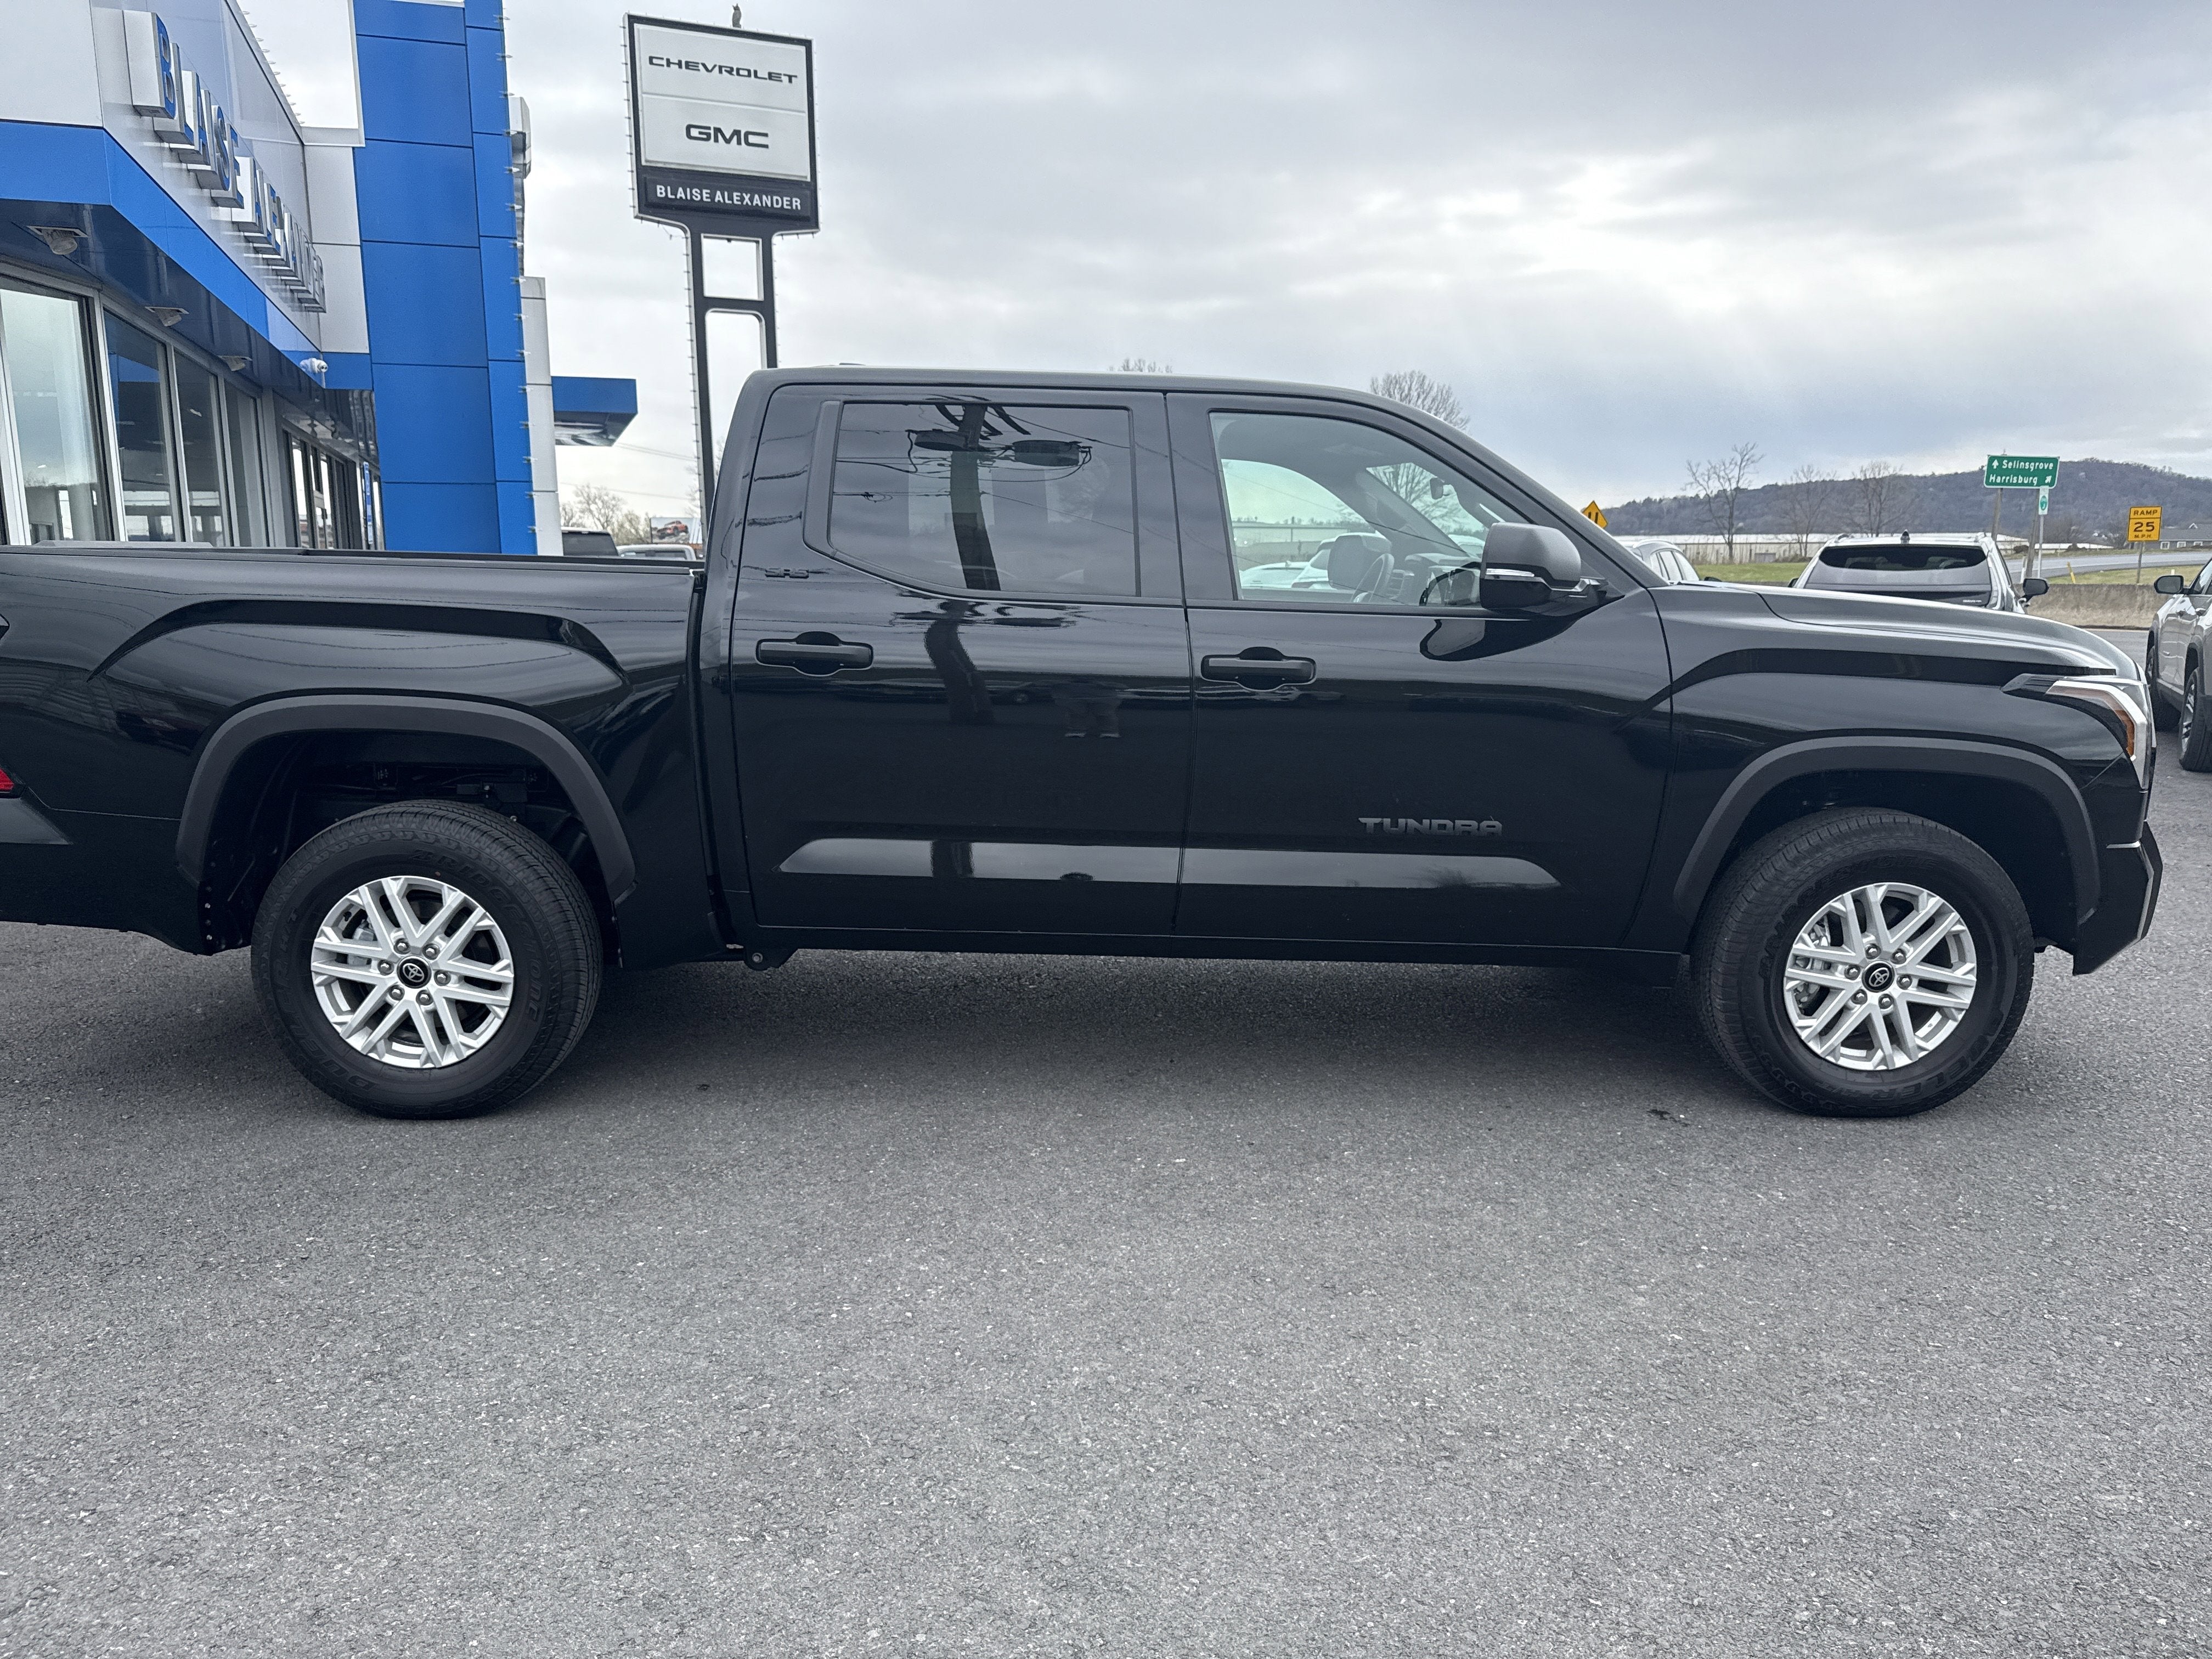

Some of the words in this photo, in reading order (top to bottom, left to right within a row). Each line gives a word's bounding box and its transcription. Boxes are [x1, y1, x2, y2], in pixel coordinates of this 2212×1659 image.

[648, 55, 798, 83] CHEVROLET
[686, 123, 769, 149] GMC
[657, 185, 711, 202] BLAISE
[714, 190, 801, 211] ALEXANDER
[2002, 460, 2053, 471] Selinsgrove
[1989, 474, 2038, 486] Harrisburg
[2133, 521, 2155, 532] 25
[765, 567, 809, 579] SR5
[1358, 817, 1503, 837] TUNDRA
